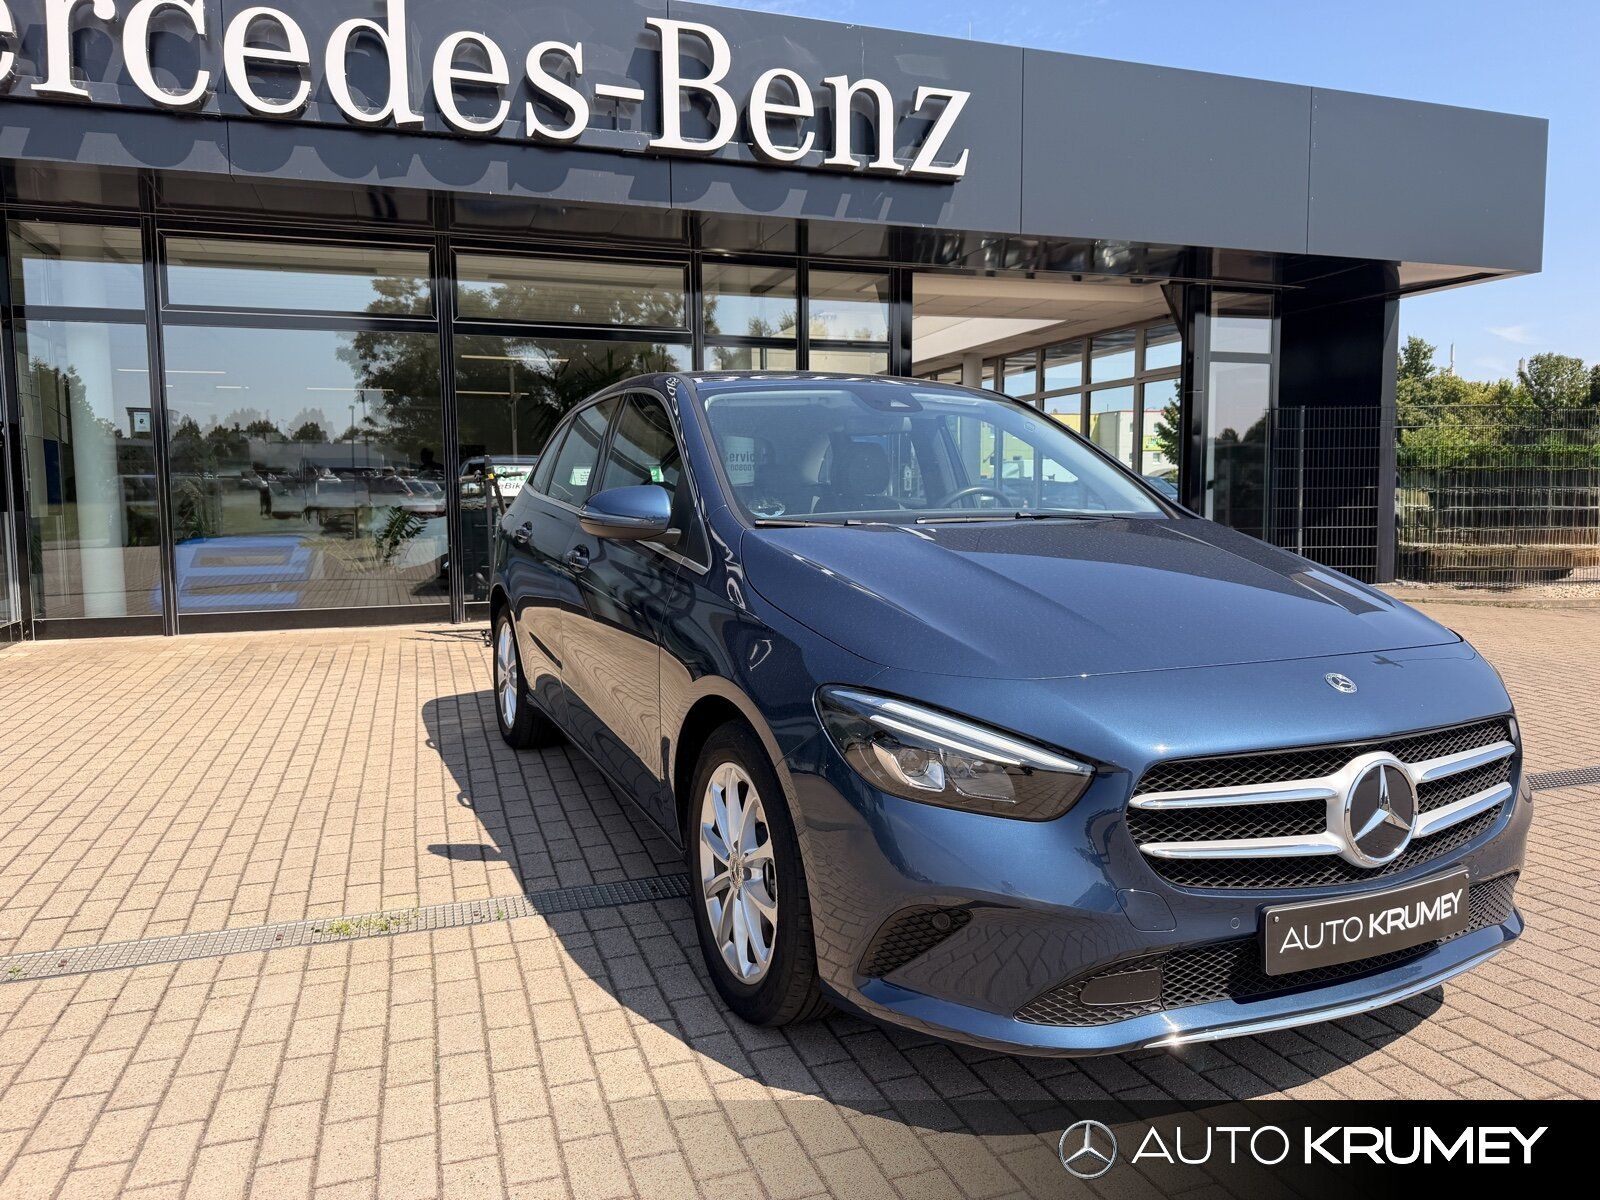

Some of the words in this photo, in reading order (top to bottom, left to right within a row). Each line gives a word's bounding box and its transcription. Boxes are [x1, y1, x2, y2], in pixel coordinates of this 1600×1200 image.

[0, 0, 971, 178] rcedes-Benz
[1279, 916, 1364, 954] AUTO
[1368, 888, 1464, 939] KRUMEY
